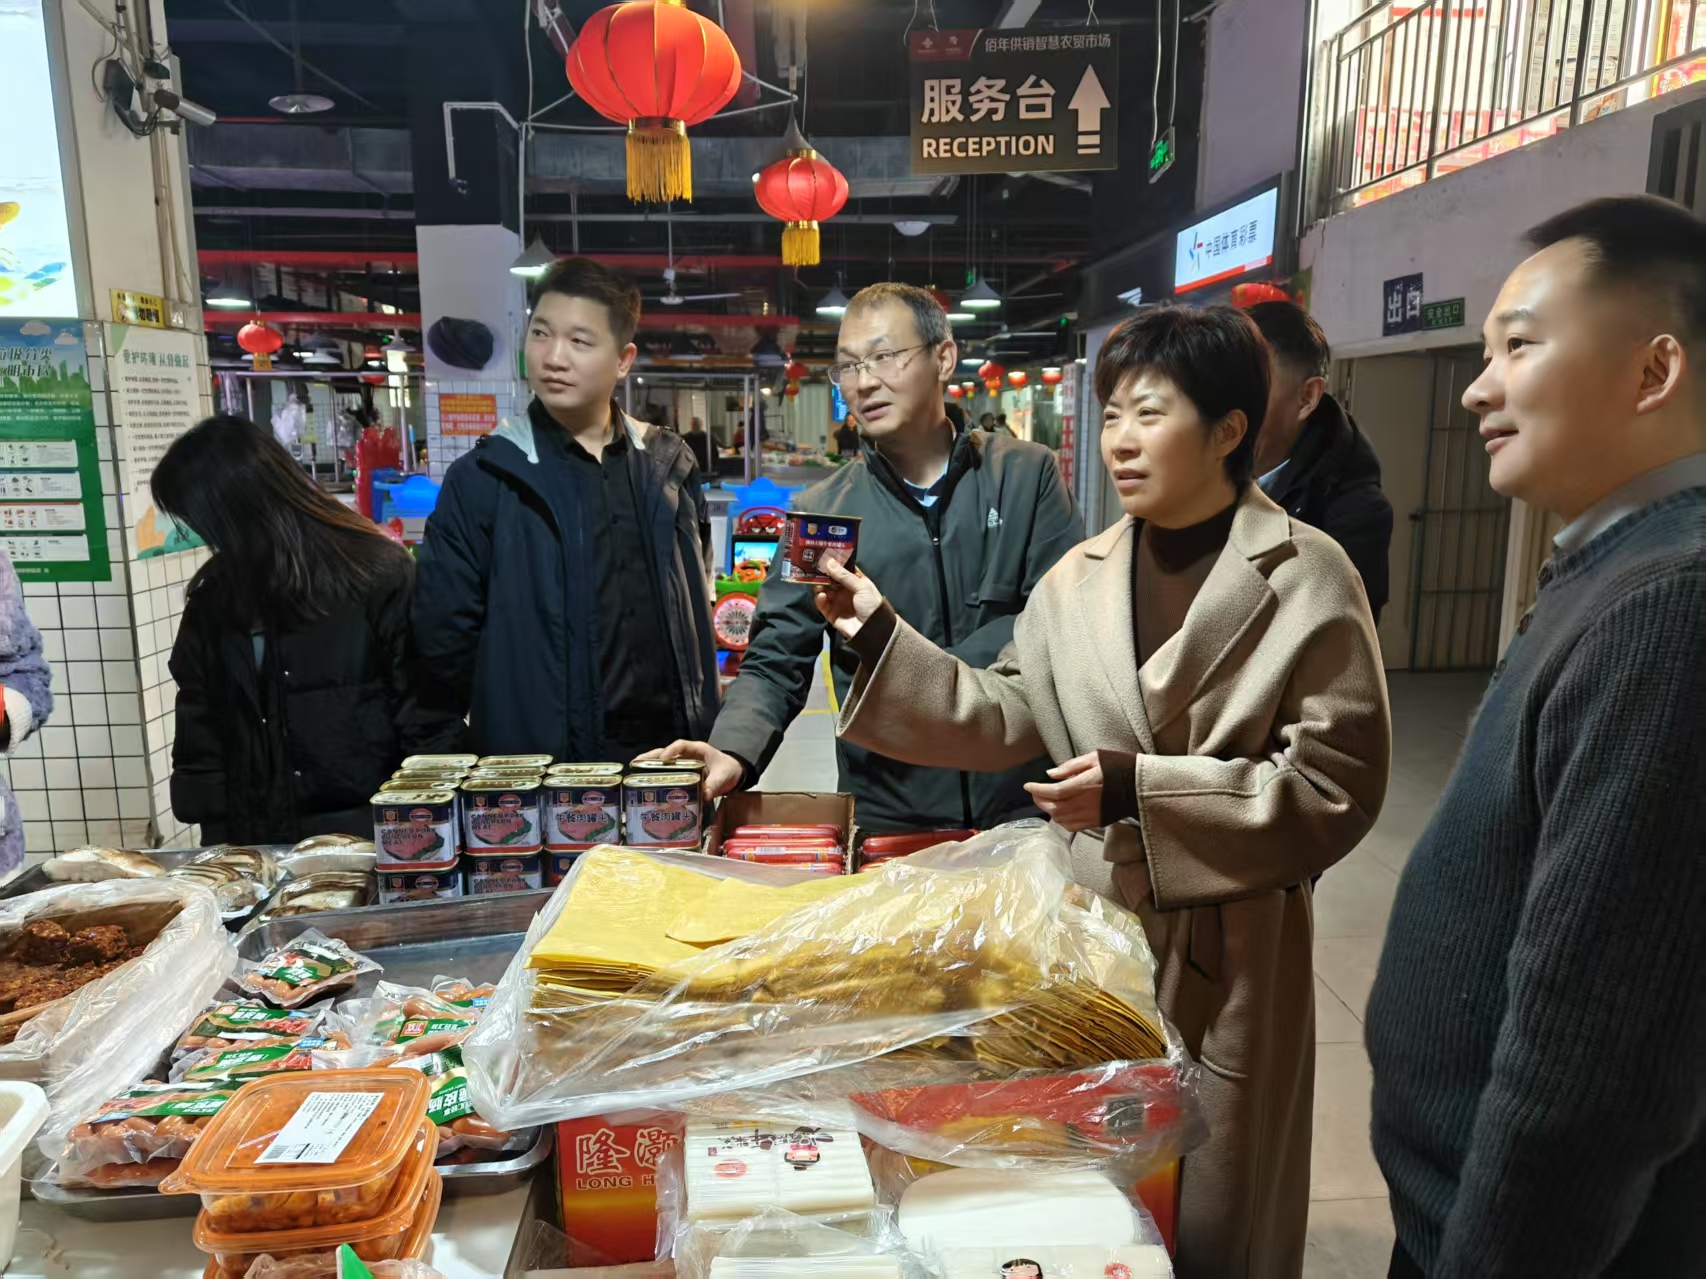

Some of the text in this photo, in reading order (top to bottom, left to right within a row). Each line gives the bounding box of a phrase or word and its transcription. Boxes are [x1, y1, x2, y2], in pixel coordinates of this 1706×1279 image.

[985, 34, 1111, 52] 佰年供销智慧农贸市场
[922, 75, 1056, 123] 服务台
[922, 135, 1055, 158] RECEPTION
[1387, 290, 1421, 323] 出口
[556, 812, 608, 824] 午餐肉罐头
[641, 811, 692, 822] 午餐肉罐头
[576, 1176, 633, 1190] LONG
